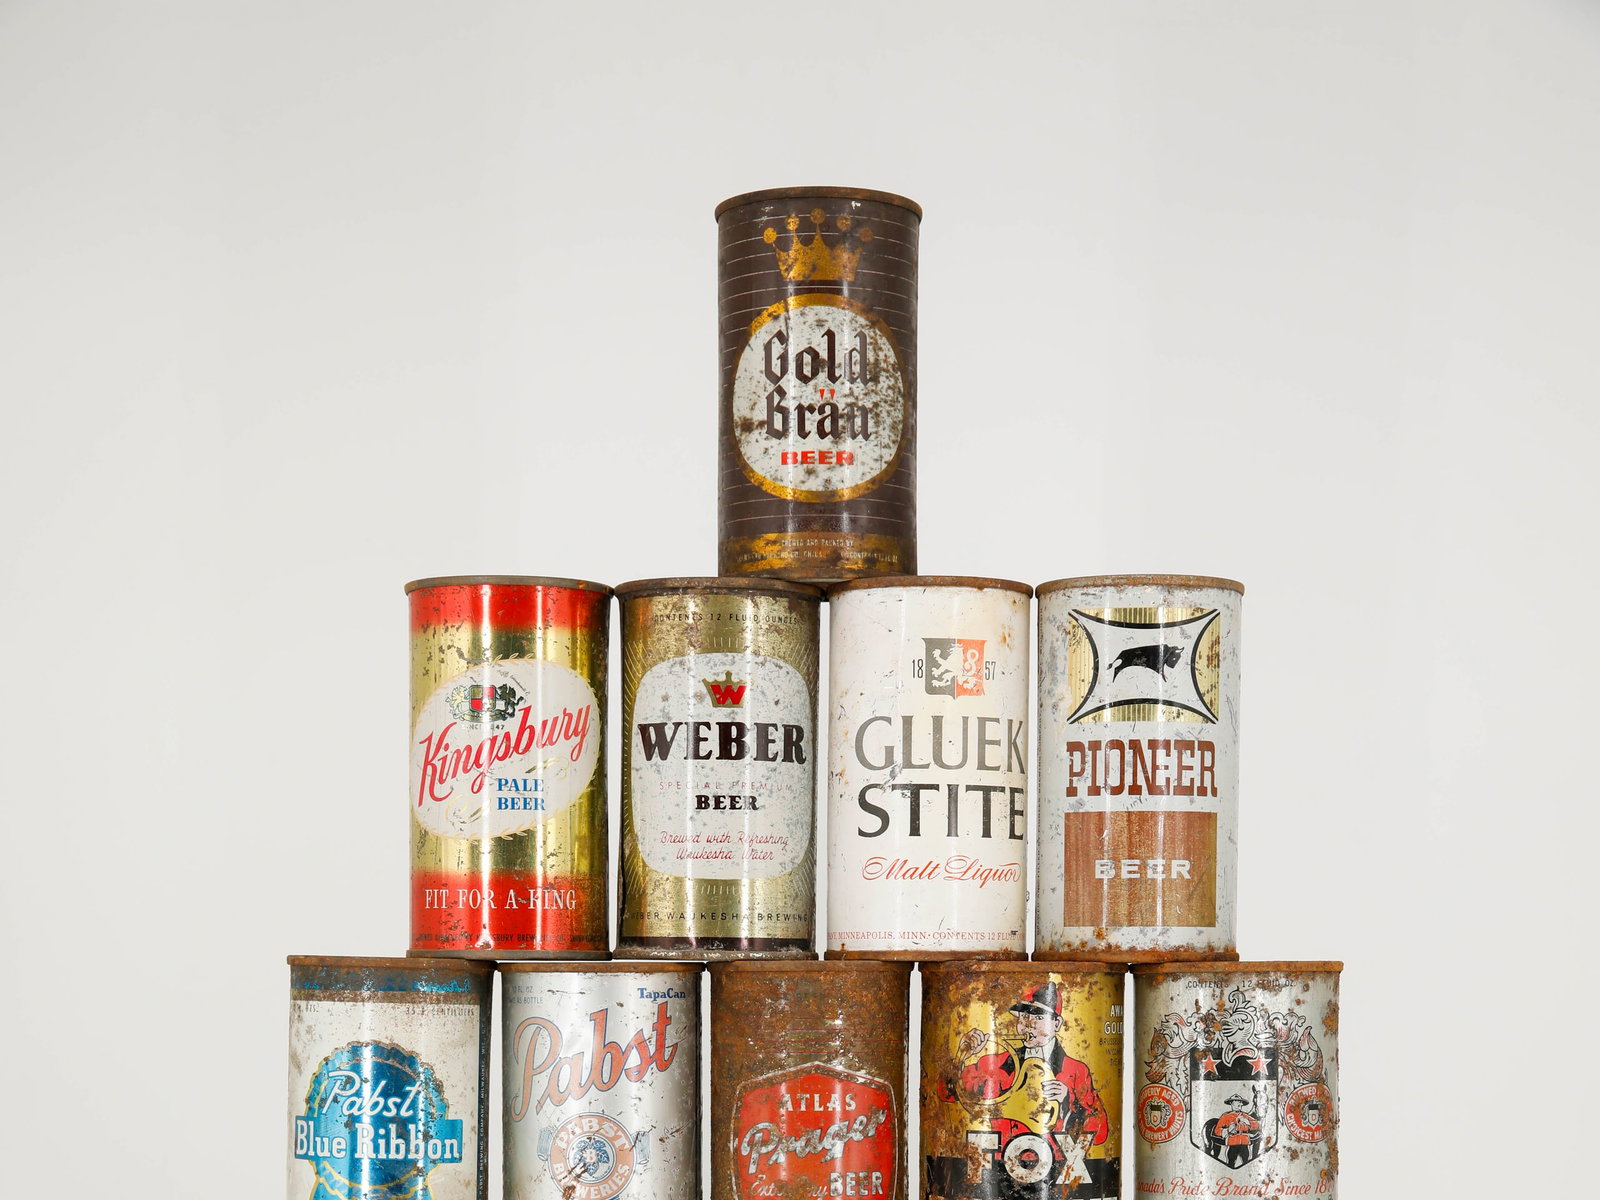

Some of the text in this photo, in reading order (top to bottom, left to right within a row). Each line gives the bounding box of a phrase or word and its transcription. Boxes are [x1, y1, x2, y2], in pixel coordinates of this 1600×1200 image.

[763, 328, 872, 386] Gold
[765, 384, 872, 441] Bräu
[781, 451, 854, 465] BEER
[654, 613, 703, 622] CONTENTS
[729, 614, 758, 622] FLUID
[765, 615, 798, 625] OUNCES
[912, 659, 996, 681] 18 57
[710, 684, 747, 705] W
[638, 722, 807, 765] WEBER
[855, 715, 1025, 774] GLUEK
[418, 705, 591, 807] Kingsbury
[1066, 739, 1218, 798] PIONEER
[497, 778, 544, 792] PALE
[497, 797, 545, 810] BEER
[695, 795, 759, 810] BEER
[857, 783, 1024, 841] STITE
[706, 831, 732, 843] with
[862, 854, 1021, 888] Malt Liquor
[1095, 859, 1192, 879] BEER
[425, 889, 577, 910] FIT FOR A KING
[758, 913, 809, 922] BREWING
[637, 987, 686, 1001] TapaCan
[1242, 980, 1253, 988] 12
[511, 1000, 679, 1122] Pabst
[322, 1070, 422, 1117] Pabst
[778, 1093, 856, 1112] ATLAS
[296, 1119, 459, 1159] Blue Ribbon
[741, 1108, 887, 1174] Prager
[966, 1130, 1097, 1184] FOX
[829, 1171, 884, 1196] BEER
[1212, 1177, 1269, 1197] Brand
[1274, 1178, 1311, 1195] Since
